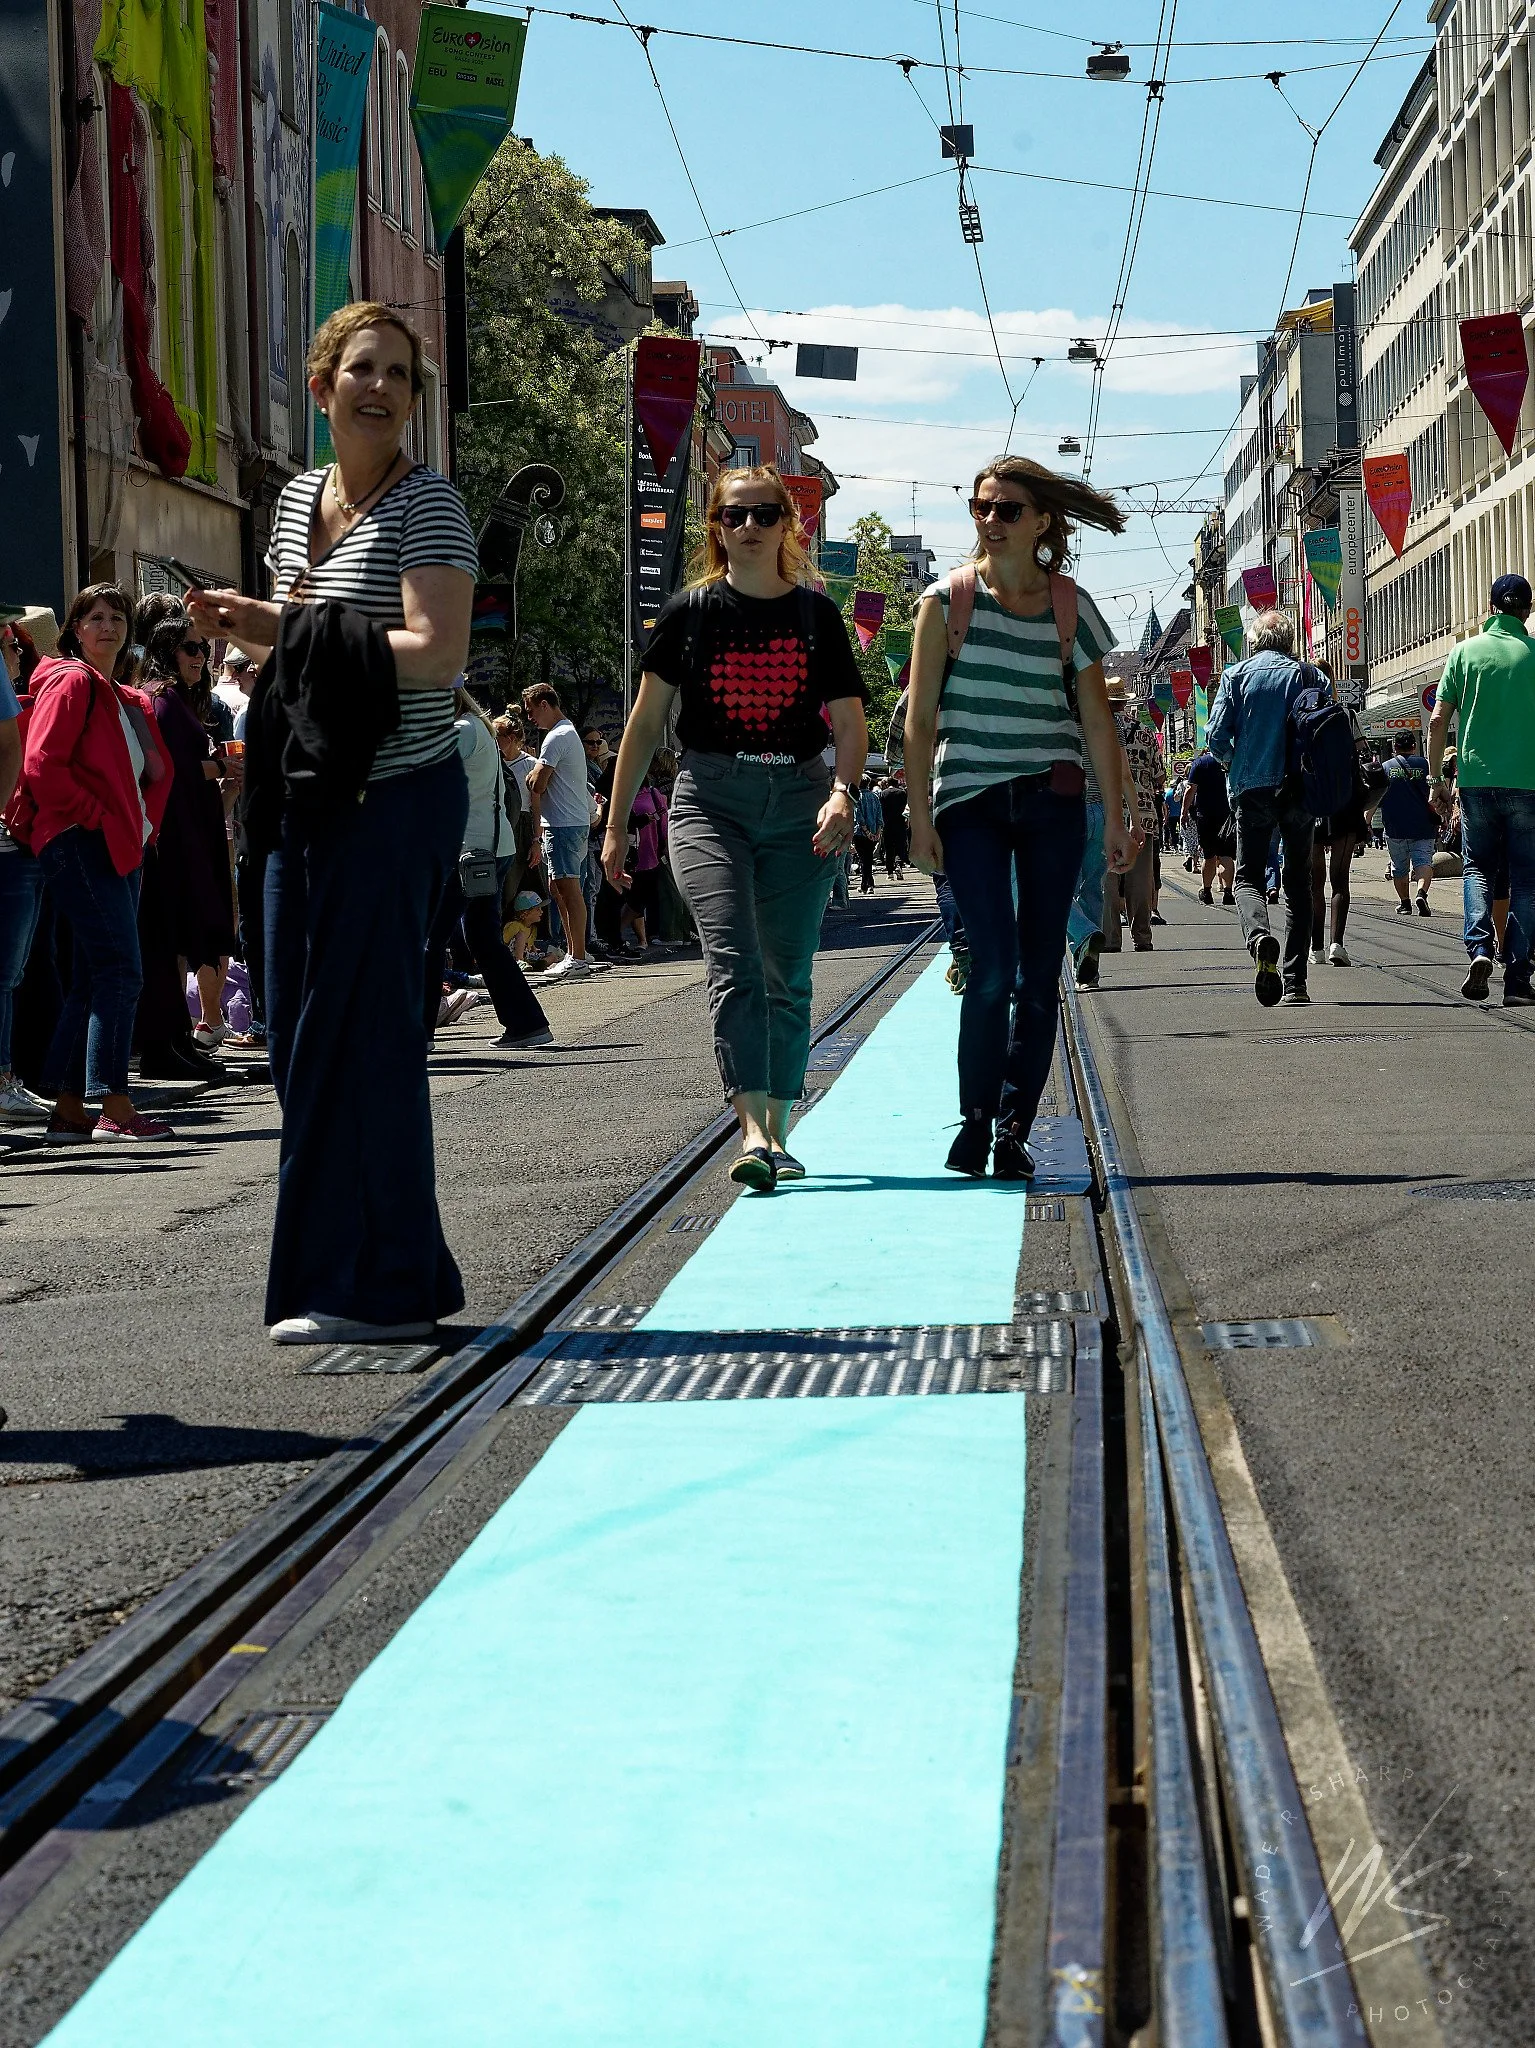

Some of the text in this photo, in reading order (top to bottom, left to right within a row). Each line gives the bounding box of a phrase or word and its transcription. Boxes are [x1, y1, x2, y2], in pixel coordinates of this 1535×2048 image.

[319, 36, 366, 76] United
[444, 47, 496, 60] SONG CONTEST
[428, 66, 448, 77] EBU
[485, 76, 505, 87] BASEL
[317, 72, 333, 106] By
[1338, 324, 1349, 387] pullman
[715, 400, 772, 423] HOTEL
[1345, 495, 1357, 575] europecenter
[1346, 607, 1362, 661] coop
[1386, 719, 1422, 730] coop
